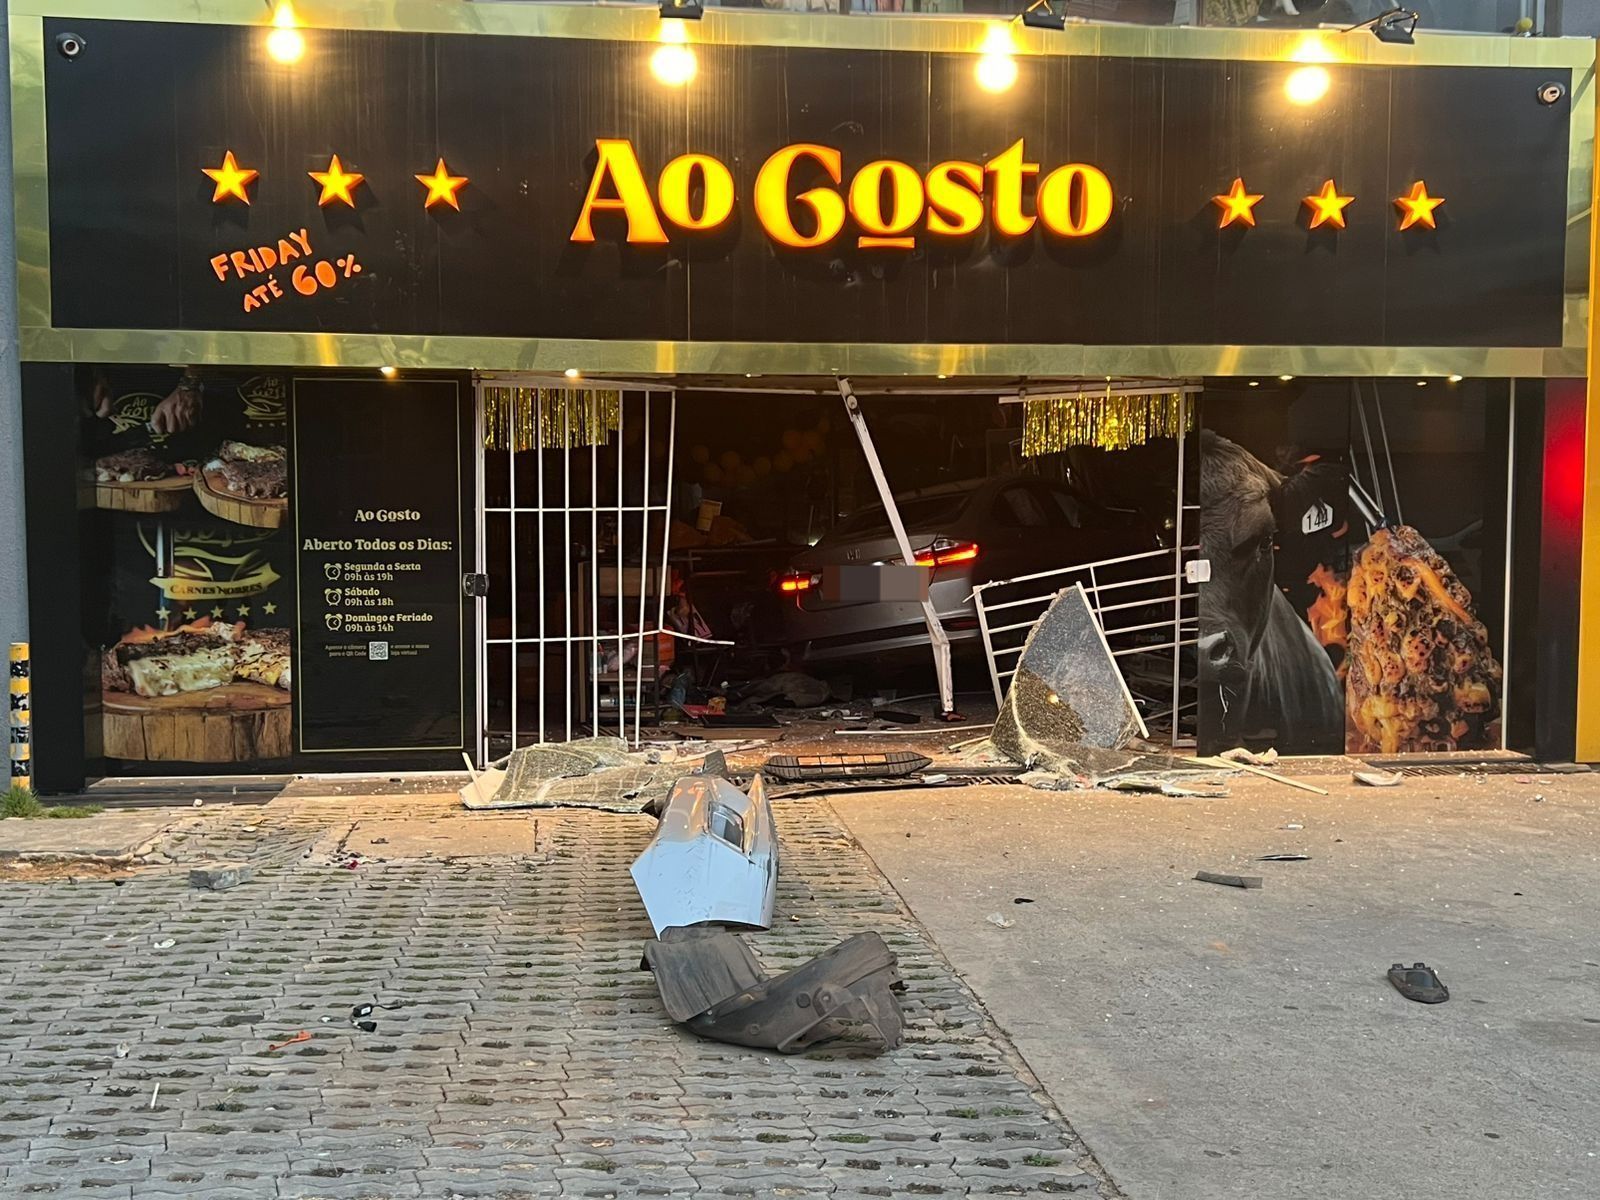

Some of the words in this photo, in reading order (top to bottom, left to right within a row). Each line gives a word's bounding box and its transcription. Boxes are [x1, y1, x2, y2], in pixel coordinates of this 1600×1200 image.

[570, 138, 735, 244] Ao
[754, 137, 1114, 248] Gosto
[210, 228, 313, 282] FRIDAY
[243, 273, 284, 313] ATÉ
[291, 254, 362, 296] 60%
[354, 509, 374, 522] Ao
[376, 508, 421, 522] Gosto
[303, 538, 352, 550] Aberto
[355, 538, 397, 550] Todos
[399, 541, 415, 550] os
[417, 538, 452, 550] Dias:
[344, 562, 385, 573] Segunda
[394, 562, 421, 571] Sexta
[344, 573, 362, 581] 09h
[364, 572, 375, 581] às
[377, 573, 394, 581] 19h
[344, 587, 380, 596] Sábado
[344, 598, 362, 606] 09h
[364, 598, 375, 606] às
[377, 598, 394, 606] 18h
[345, 613, 388, 623] Domingo
[397, 613, 433, 622] Feriado
[345, 624, 363, 632] 09h
[365, 624, 376, 632] às
[378, 624, 394, 632] 14h
